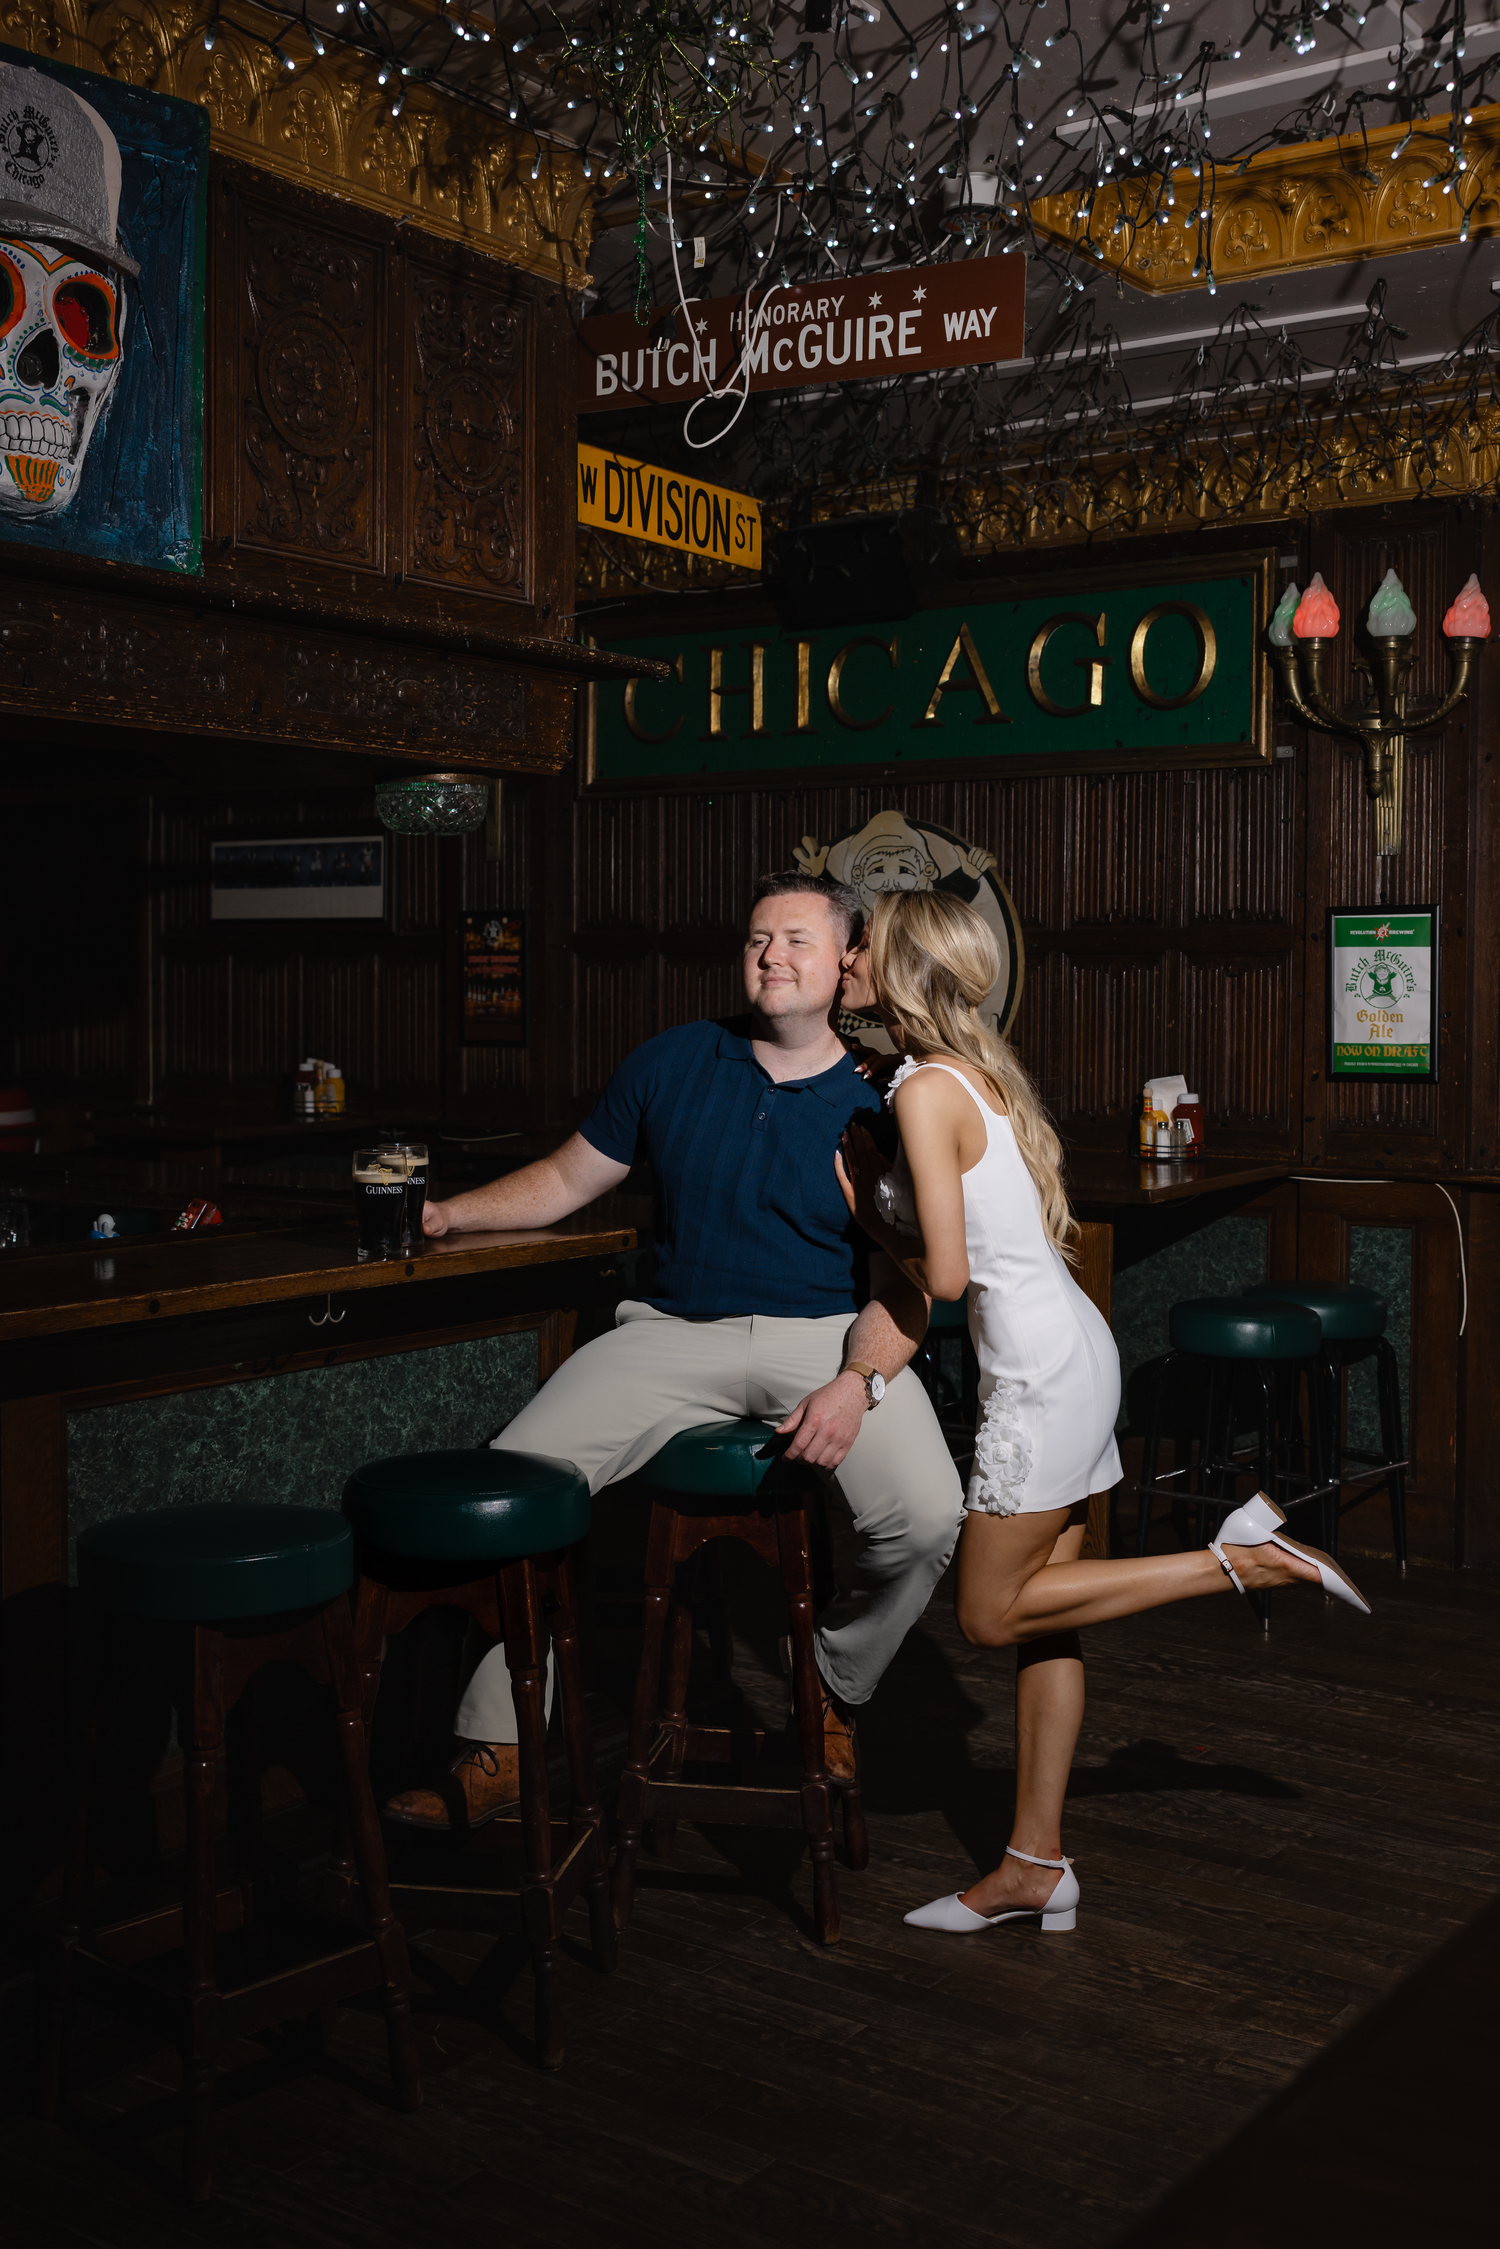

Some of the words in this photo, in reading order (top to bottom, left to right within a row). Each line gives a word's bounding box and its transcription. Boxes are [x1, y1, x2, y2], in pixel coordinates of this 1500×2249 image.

[5, 160, 45, 189] Chicago
[595, 338, 717, 397] BUTCH
[740, 309, 923, 377] McGUIRE
[942, 306, 998, 342] WAY
[580, 463, 598, 505] W
[604, 459, 731, 556] DIVISION
[735, 513, 756, 552] ST
[621, 600, 1219, 746] CHICAGO
[1345, 956, 1370, 993] Butch
[1374, 949, 1417, 993] McGuire's
[1356, 1009, 1404, 1023] Golden
[1367, 1023, 1394, 1042] Ale
[1383, 1045, 1428, 1059] DRAFT
[365, 1185, 403, 1195] GUINNESS
